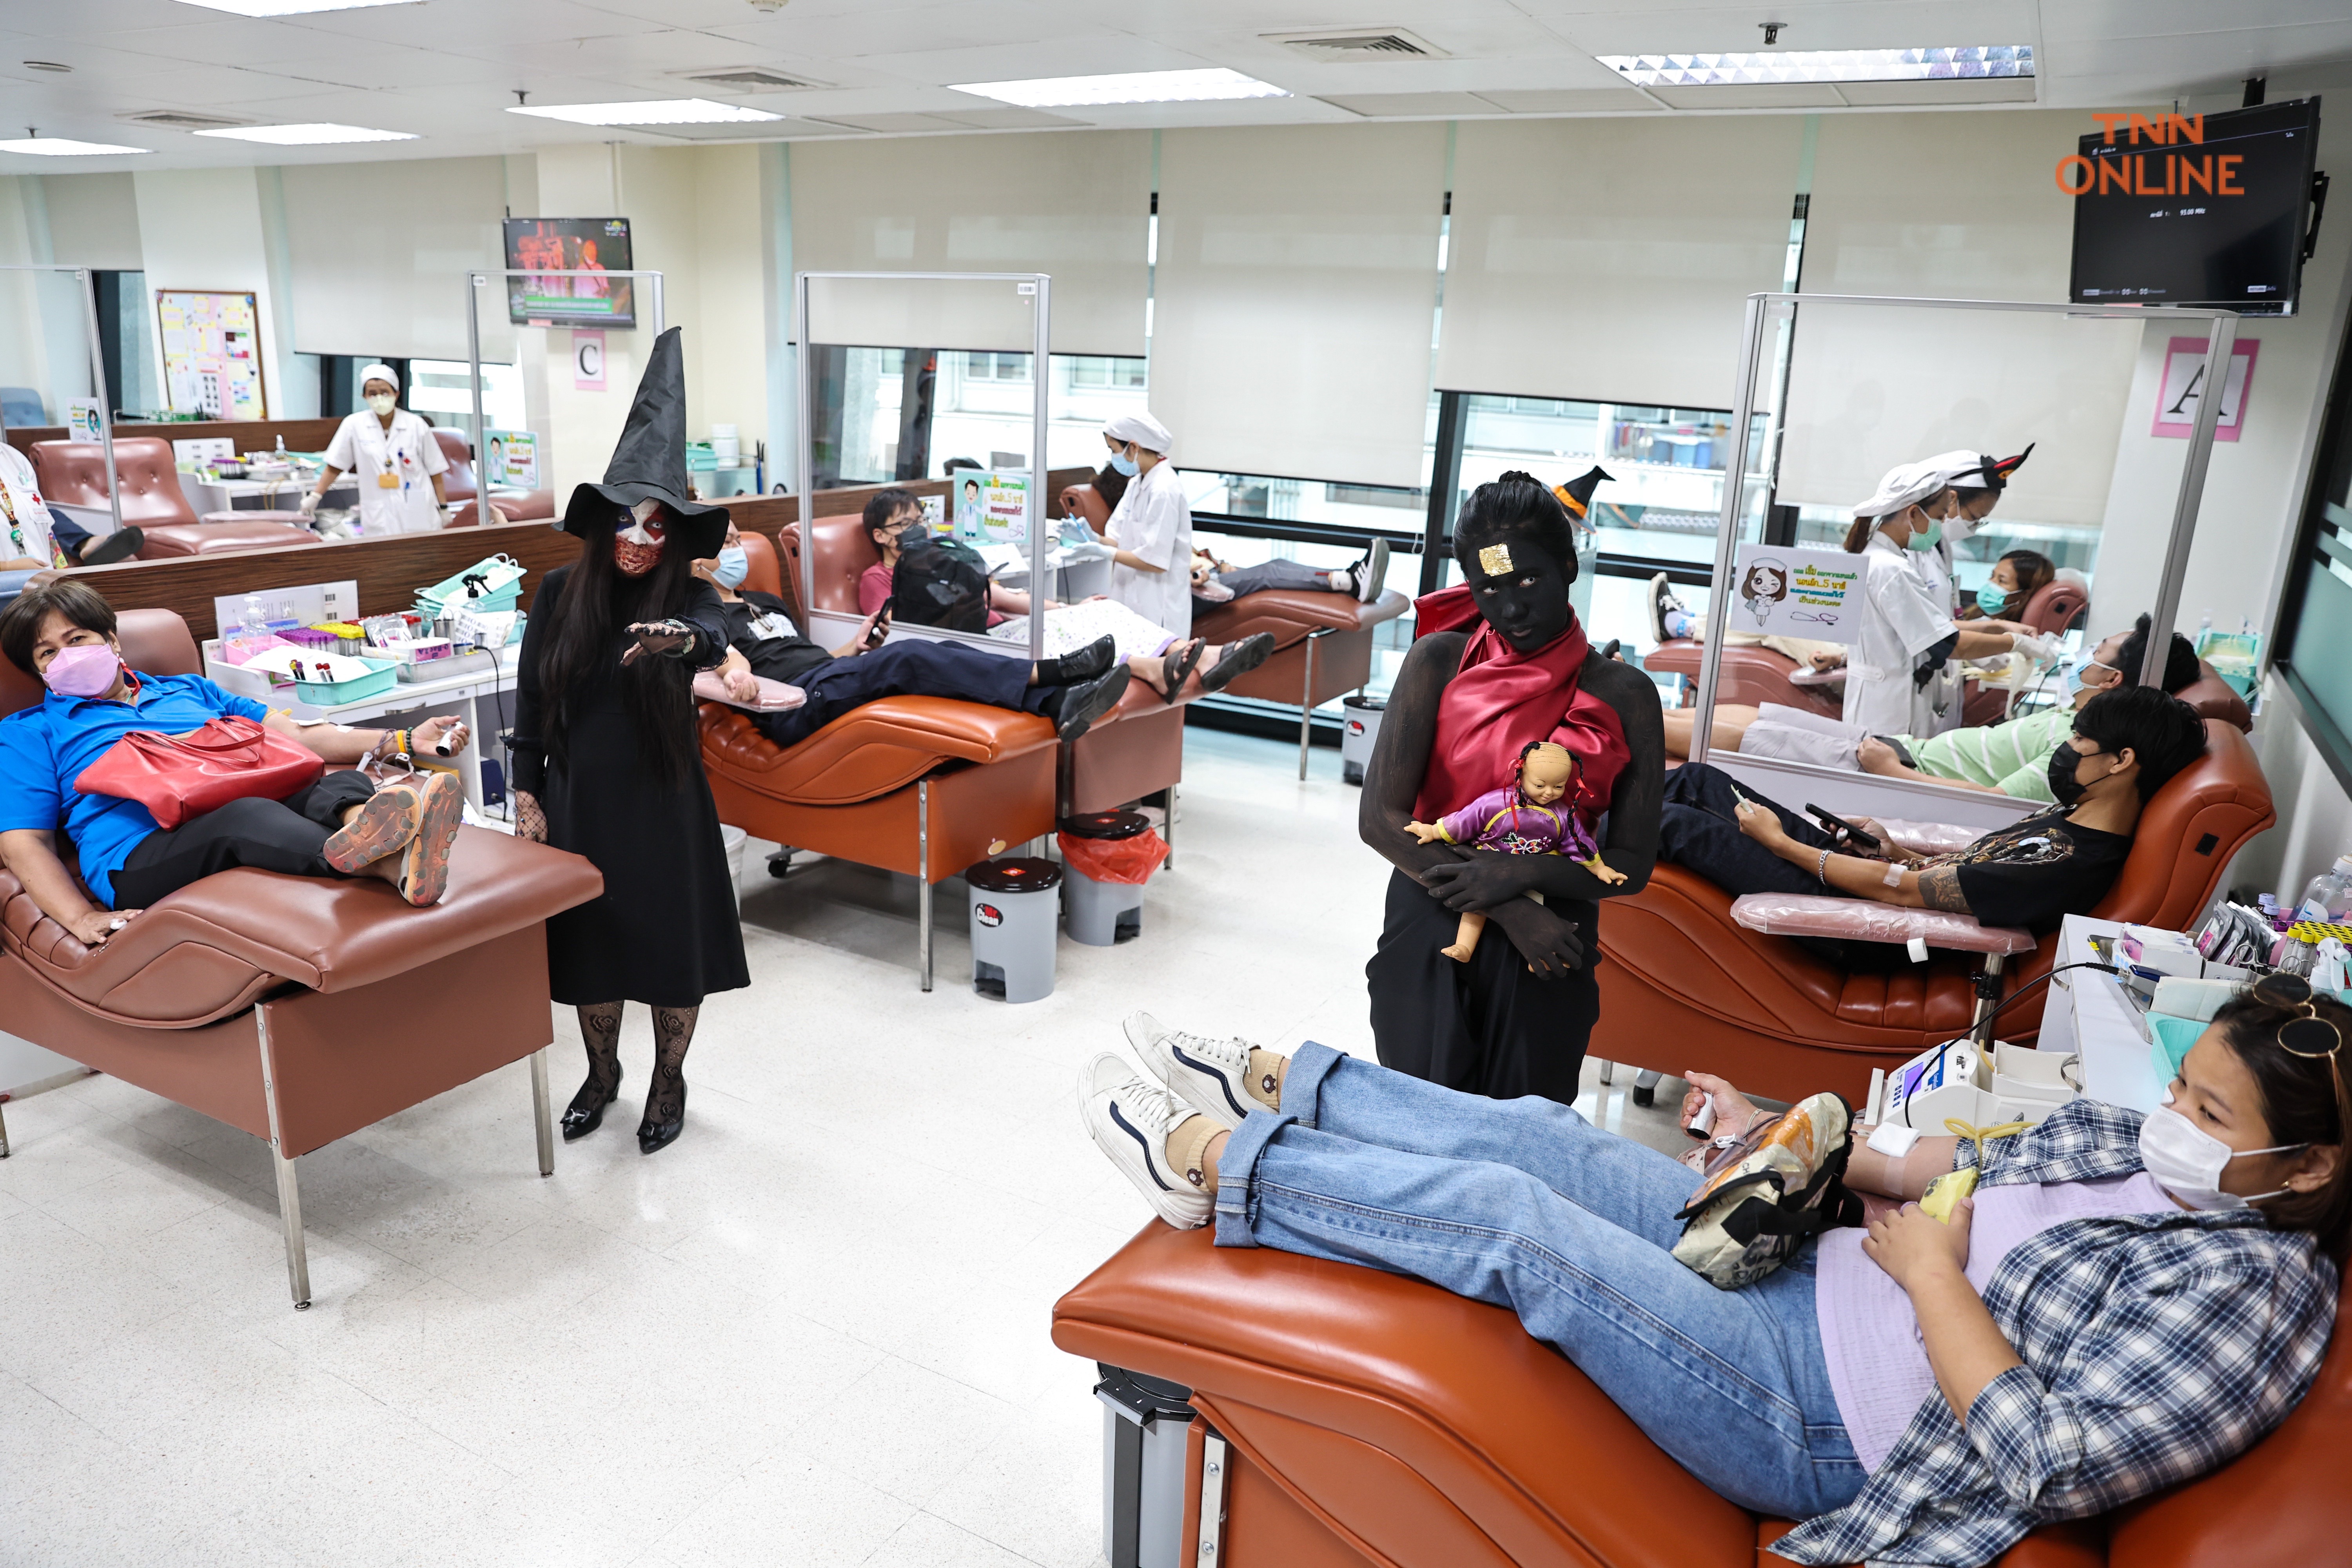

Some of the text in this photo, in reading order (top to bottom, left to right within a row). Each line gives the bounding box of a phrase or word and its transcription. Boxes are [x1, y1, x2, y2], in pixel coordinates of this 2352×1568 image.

[579, 344, 598, 376] C
[977, 907, 999, 926] Clean
[985, 906, 999, 918] Mr.
